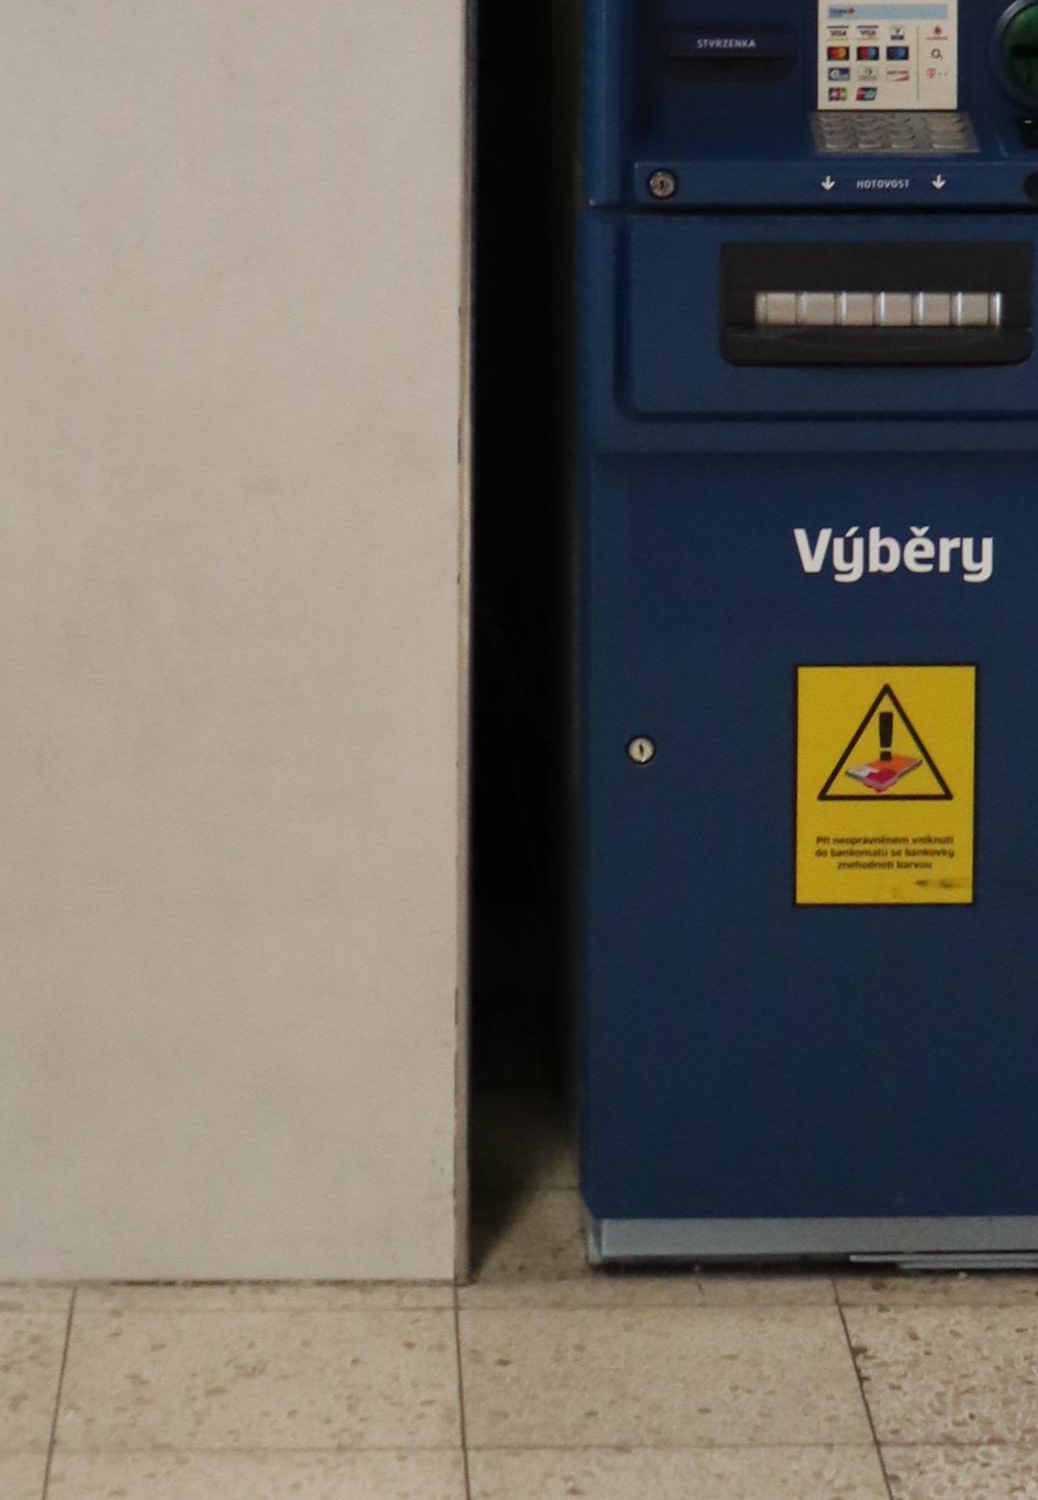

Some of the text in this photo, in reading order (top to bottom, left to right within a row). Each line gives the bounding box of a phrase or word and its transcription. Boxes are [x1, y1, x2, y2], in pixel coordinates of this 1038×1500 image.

[697, 38, 756, 49] STVRZENKA
[856, 178, 911, 189] HOTOVOST
[793, 526, 994, 583] Výběry
